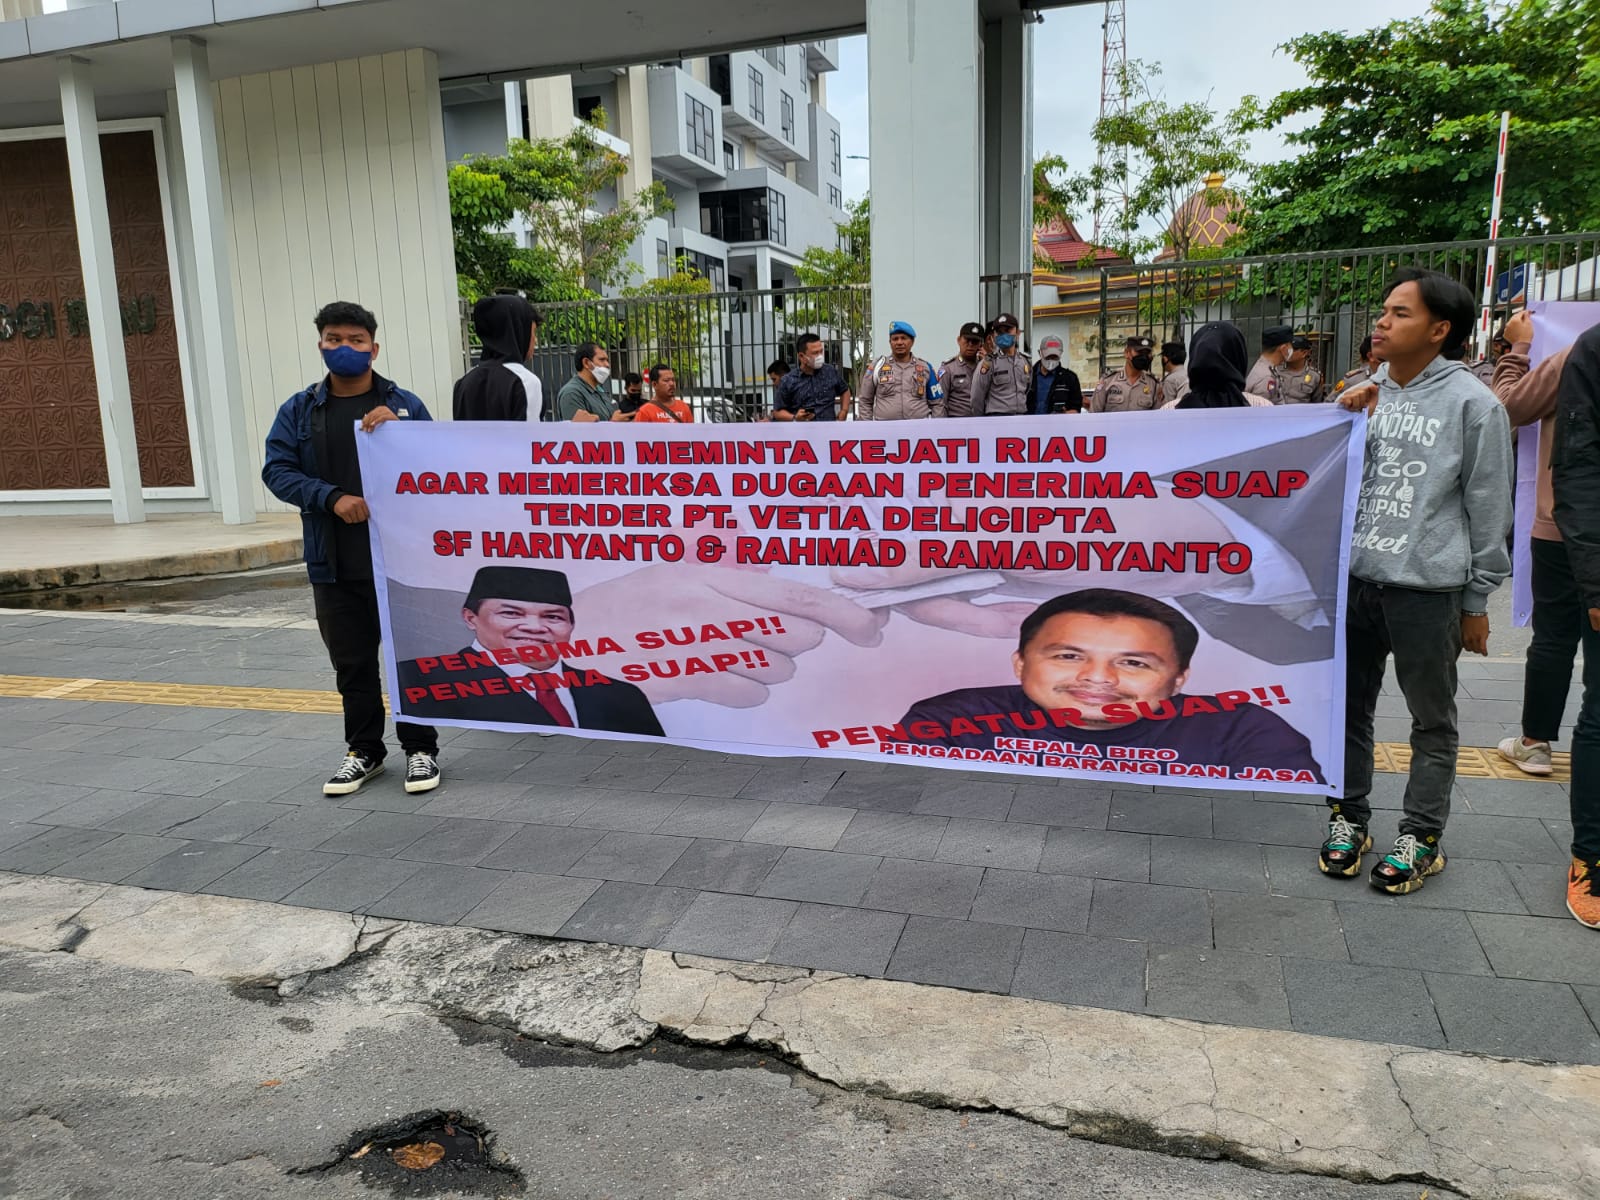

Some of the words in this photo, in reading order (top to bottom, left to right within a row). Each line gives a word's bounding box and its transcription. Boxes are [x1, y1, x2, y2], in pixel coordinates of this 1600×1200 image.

[1367, 412, 1441, 448] ANDPAS
[531, 441, 624, 465] KAMI
[636, 440, 817, 465] MEMINTA
[830, 438, 980, 464] KEJATI
[995, 436, 1107, 463] RIAU
[396, 472, 487, 495] AGAR
[498, 472, 721, 497] MEMERIKSA
[732, 472, 905, 498] DUGAAN
[917, 471, 1157, 499] PENERIMA
[1171, 470, 1309, 498] SUAP
[524, 502, 671, 528] TENDER
[683, 504, 737, 530] PT.
[749, 504, 870, 531] VETIA
[881, 505, 1115, 534] DELICIPTA
[432, 529, 472, 558] SF
[481, 531, 685, 563] HARIYANTO
[696, 535, 726, 564] &
[735, 536, 907, 567] RAHMAD
[918, 539, 1253, 575] RAMADIYANTO
[414, 636, 625, 676] PENERIMA
[637, 614, 788, 651] SUAP!!
[404, 668, 612, 706] PENERIMA
[620, 648, 771, 684] SUAP!!
[812, 706, 1089, 750] PENGATUR
[1099, 683, 1292, 726] SUAP!!
[878, 741, 1037, 766] PENGADAAN
[1044, 755, 1159, 775] BARANG
[1168, 762, 1227, 779] DAN
[1236, 767, 1316, 784] JASA
[995, 736, 1101, 760] KEPALA
[1108, 746, 1179, 761] BIRO
